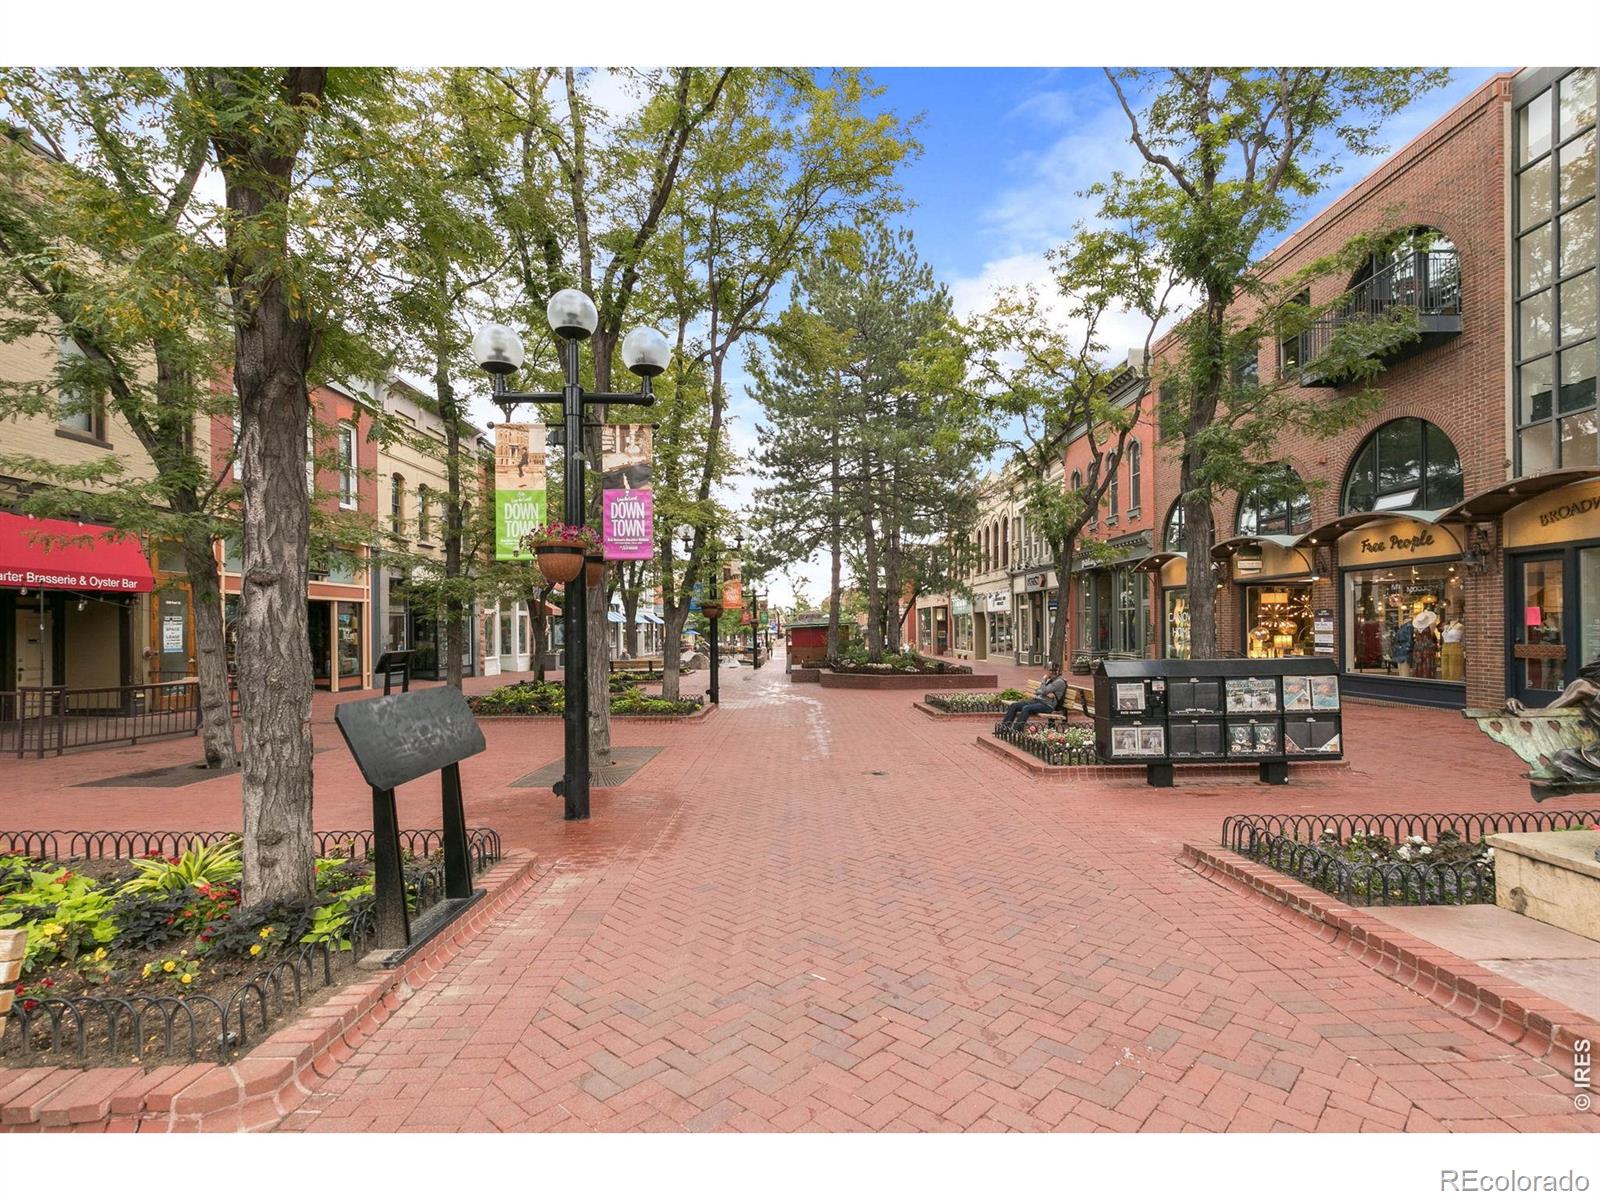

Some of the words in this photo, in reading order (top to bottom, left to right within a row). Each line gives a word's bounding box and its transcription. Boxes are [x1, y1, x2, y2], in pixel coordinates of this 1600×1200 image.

[504, 502, 539, 520] DOWN
[611, 502, 645, 519] DOWN
[611, 519, 645, 537] TOWN
[1361, 538, 1385, 553] Free
[1390, 529, 1435, 553] People
[26, 571, 77, 586] Brasserie
[79, 575, 88, 586] &
[89, 575, 121, 589] Oyster
[121, 578, 138, 589] Bar
